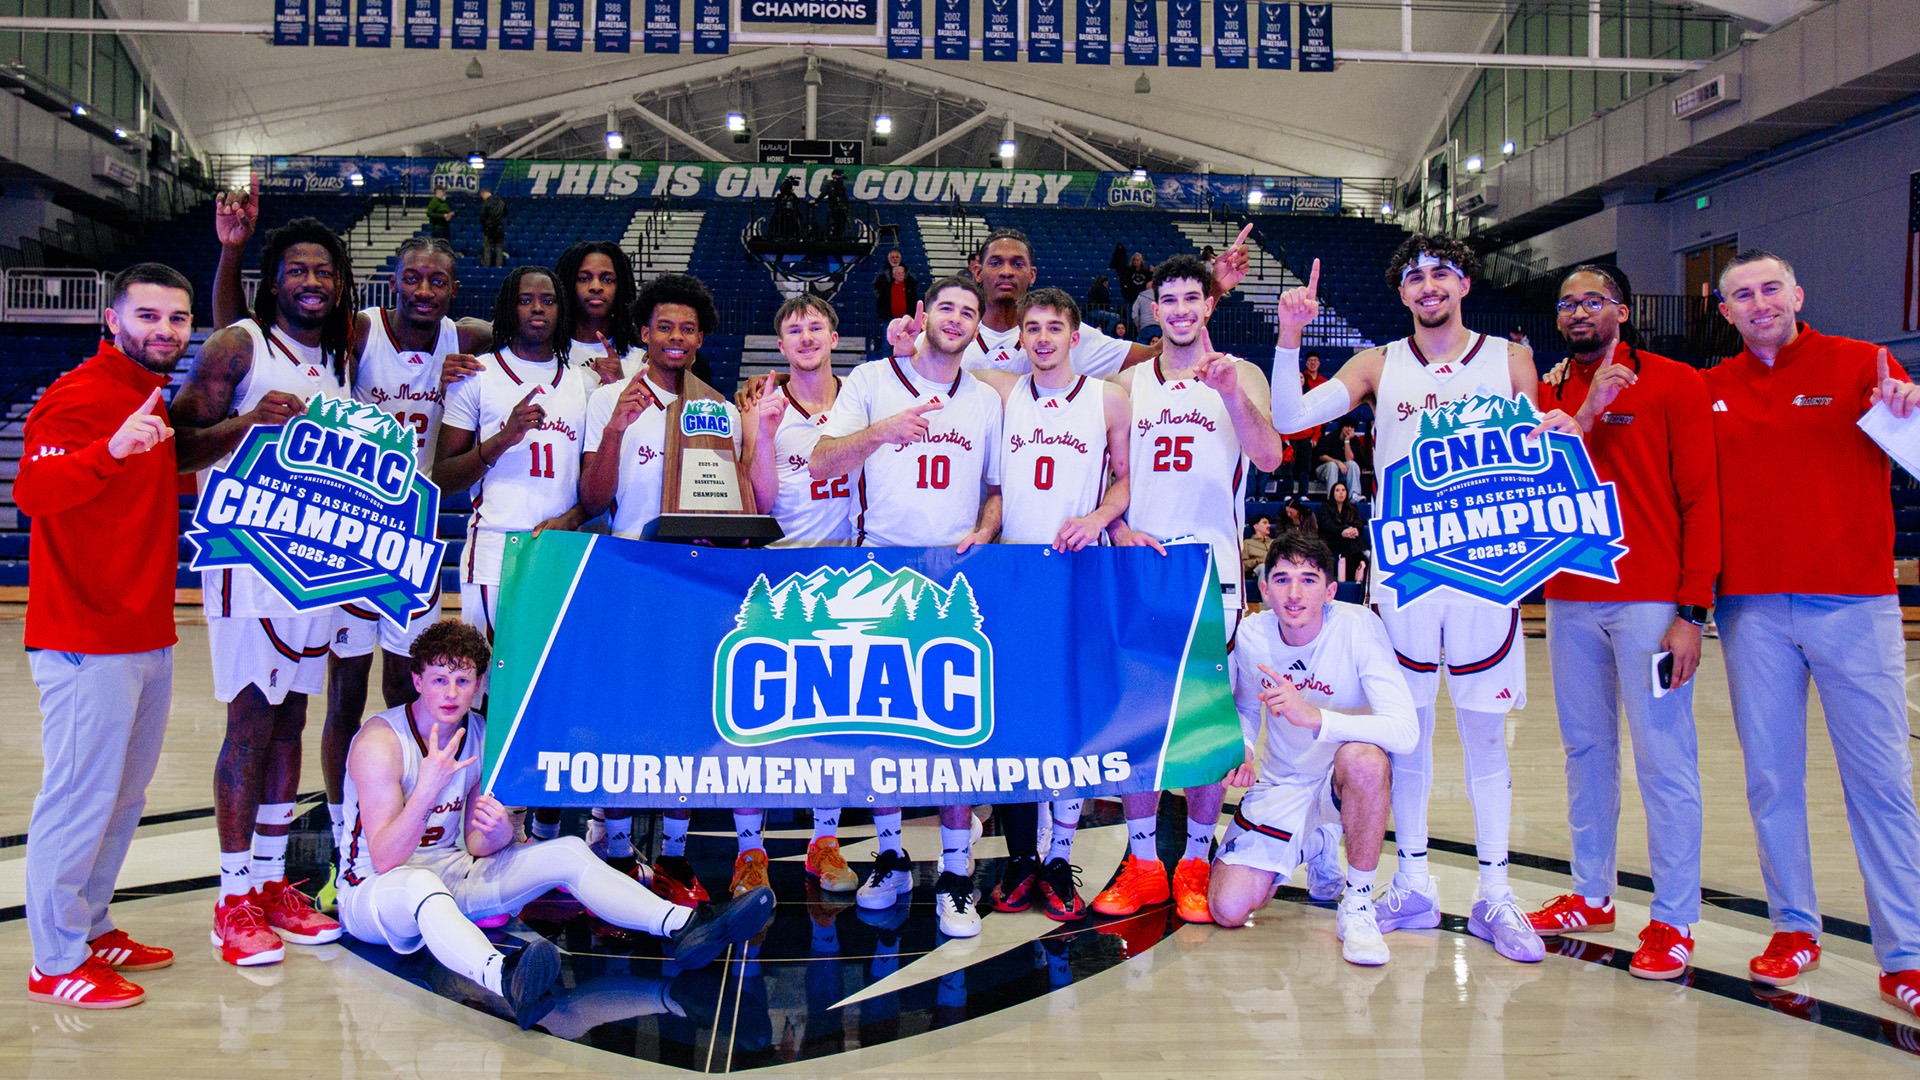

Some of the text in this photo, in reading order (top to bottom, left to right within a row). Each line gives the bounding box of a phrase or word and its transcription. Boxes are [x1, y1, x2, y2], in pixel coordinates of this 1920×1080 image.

[654, 5, 670, 14] 1994
[704, 6, 719, 15] 2001
[752, 2, 867, 19] CHAMPIONS
[898, 11, 913, 20] 2001
[944, 12, 960, 21] 2002
[992, 14, 1008, 23] 2005
[1037, 15, 1054, 24] 2009
[1086, 16, 1101, 25] 2012
[1177, 20, 1191, 29] 2013
[1261, 39, 1288, 47] BASKETBALL
[262, 178, 290, 187] MAKE
[304, 172, 345, 192] YOURS
[434, 174, 477, 190] GNAC
[528, 164, 1072, 204] THIS IS GNAC COUNTRY
[1111, 188, 1153, 204] GNAC
[1258, 191, 1329, 211] AKE IT YOURS
[371, 387, 391, 405] St.
[1397, 402, 1417, 421] St.
[541, 417, 577, 441] artins
[685, 415, 728, 432] GNAC
[1138, 408, 1216, 437] St. Martins
[1010, 428, 1088, 454] St. Martins
[287, 421, 408, 495] GNAC
[530, 442, 554, 478] 11
[638, 446, 657, 465] St.
[789, 455, 808, 471] St.
[1153, 436, 1194, 472] 25
[1419, 425, 1541, 481] GNAC
[916, 455, 950, 489] 10
[1034, 456, 1055, 490] 0
[304, 476, 345, 489] ANNIVERSARY
[810, 474, 850, 500] 22
[1449, 478, 1489, 492] ANNIVERSARY
[259, 474, 406, 532] MEN'S BASKETBALL
[1411, 483, 1567, 515] MEN'S BASKETBALL
[207, 478, 435, 588] CHAMPION
[1381, 490, 1611, 566] CHAMPION
[287, 542, 346, 570] 2025-26
[1468, 541, 1527, 561] 2025-26
[731, 642, 975, 730] GNAC
[538, 751, 1131, 794] TOURNAMENT CHAMPIONS
[433, 797, 463, 814] arti
